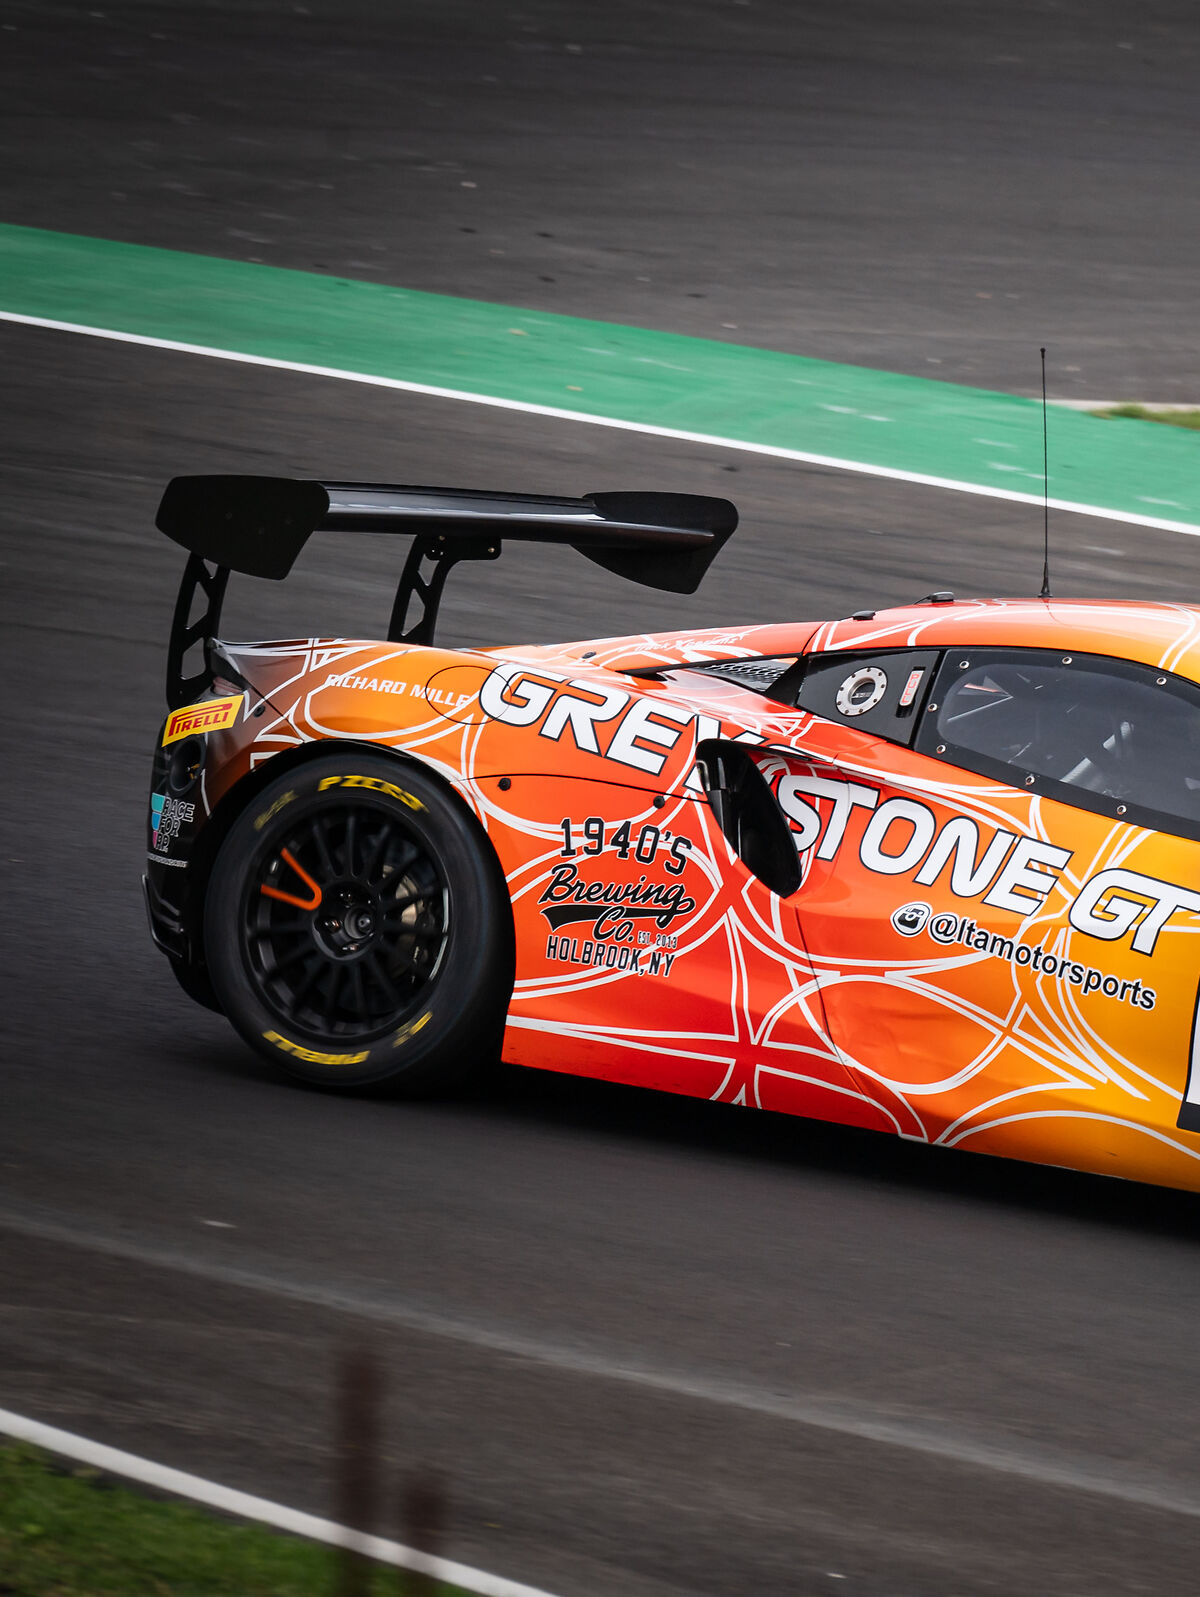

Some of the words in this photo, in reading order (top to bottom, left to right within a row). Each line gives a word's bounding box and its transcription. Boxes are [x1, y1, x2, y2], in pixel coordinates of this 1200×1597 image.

[325, 673, 407, 695] RICHARD
[410, 684, 472, 708] MILLE
[901, 673, 920, 704] PULL
[168, 702, 233, 738] PIRELLI
[159, 816, 181, 838] FOR
[162, 796, 195, 823] RACE
[560, 816, 693, 876] 1940'S
[538, 863, 696, 930] Brewing
[593, 905, 635, 942] Co.
[656, 933, 678, 949] 2013
